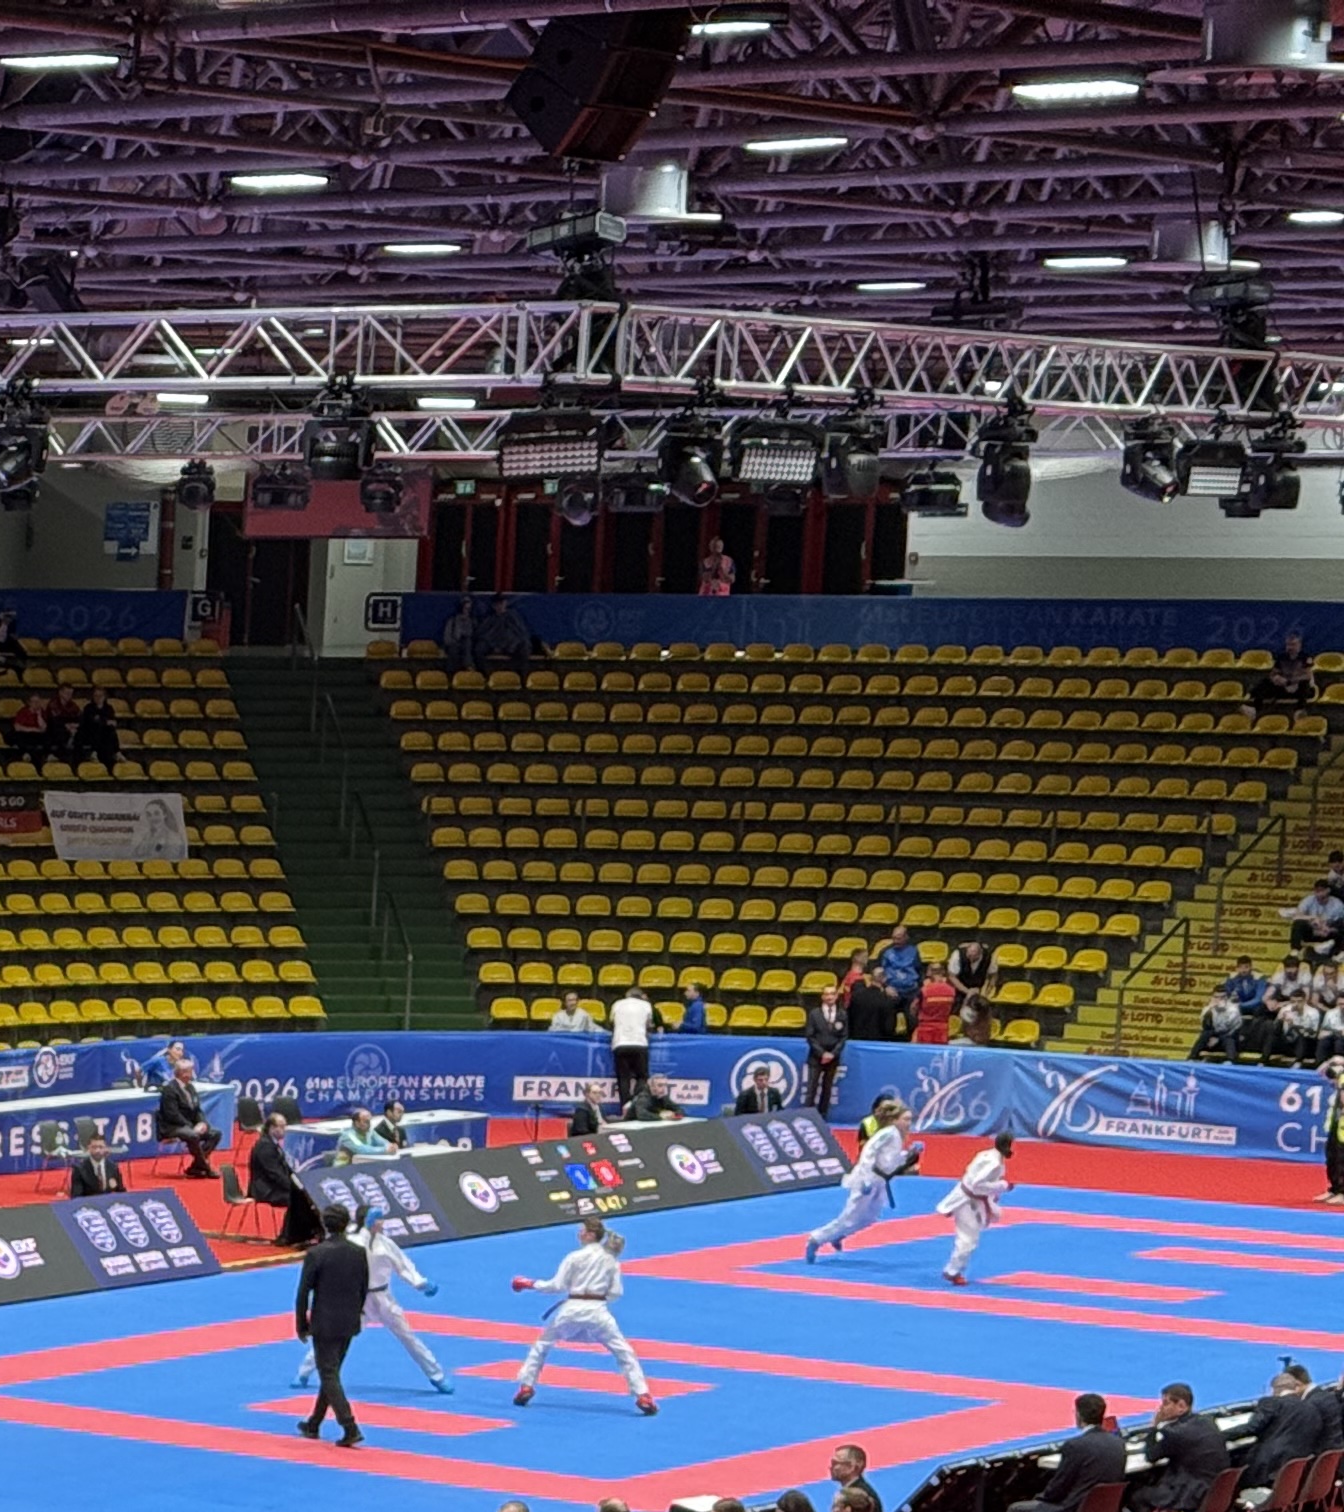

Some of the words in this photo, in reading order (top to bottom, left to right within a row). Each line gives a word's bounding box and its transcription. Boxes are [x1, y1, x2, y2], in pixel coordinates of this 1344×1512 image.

[379, 603, 393, 617] H
[45, 605, 138, 632] 2026
[9, 796, 25, 806] GO
[1130, 1010, 1163, 1024] LOTTO
[305, 1076, 335, 1090] 61st
[336, 1075, 419, 1090] EUROPEAN
[421, 1075, 485, 1089] KARATE
[305, 1088, 485, 1102] CHAMPIONSHIPS
[1105, 1119, 1215, 1142] FRANKFURT
